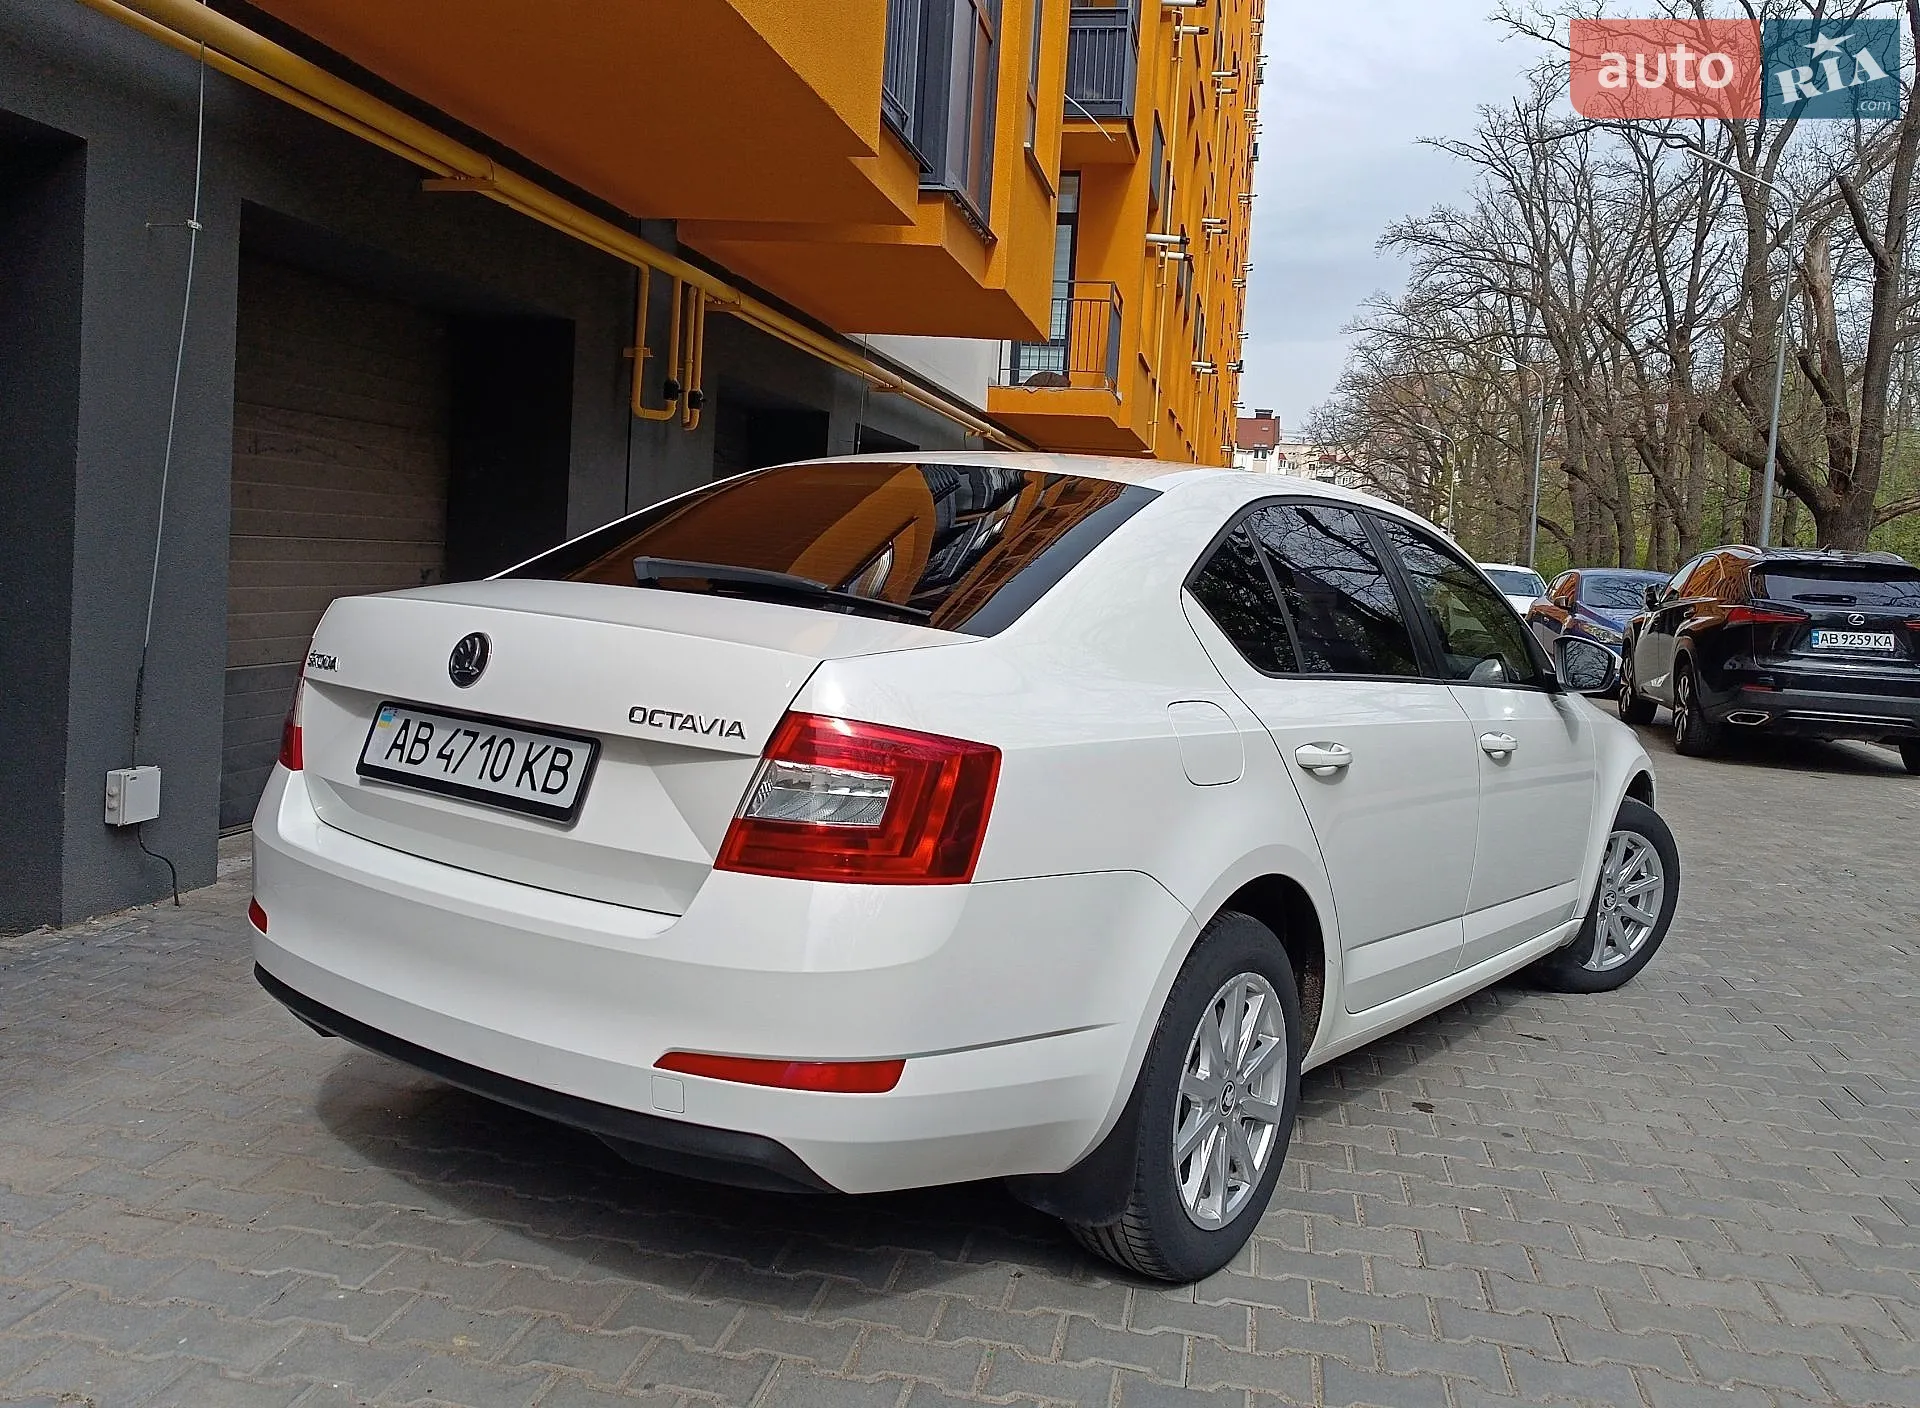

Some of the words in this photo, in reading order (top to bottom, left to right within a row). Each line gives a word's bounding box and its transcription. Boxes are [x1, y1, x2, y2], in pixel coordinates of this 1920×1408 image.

[1820, 633, 1838, 645] AB
[1841, 634, 1871, 646] 9259
[1873, 636, 1892, 647] KA
[628, 706, 746, 740] OCTAVIA
[384, 718, 435, 766] AB
[436, 728, 516, 782] 4710
[515, 741, 574, 795] KB
